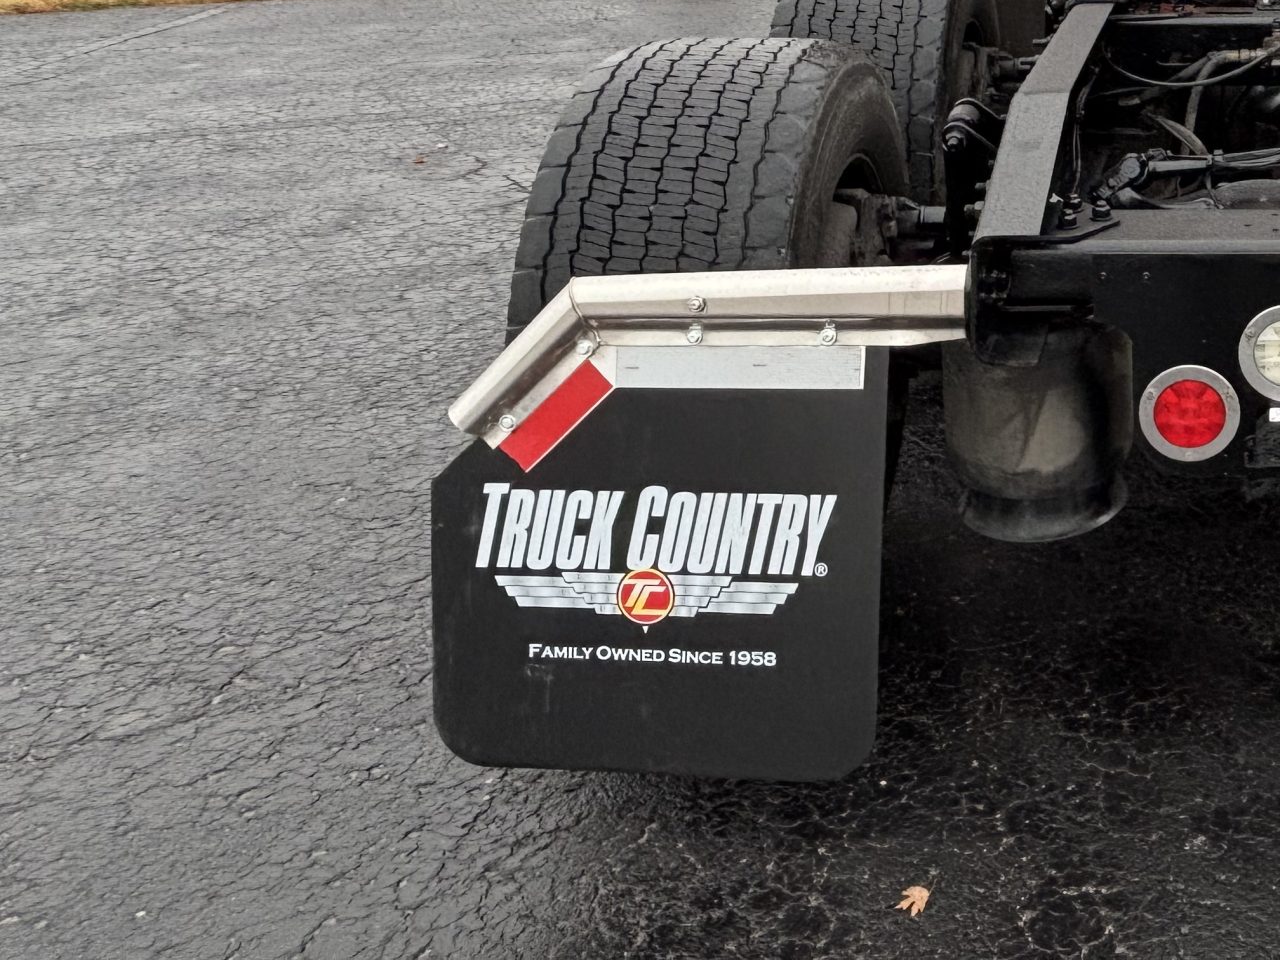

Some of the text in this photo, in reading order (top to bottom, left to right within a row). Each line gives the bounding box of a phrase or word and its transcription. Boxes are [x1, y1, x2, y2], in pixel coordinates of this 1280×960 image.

[475, 482, 625, 570] TRUCK
[528, 643, 777, 667] FAMILY OWNED SINCE 1958
